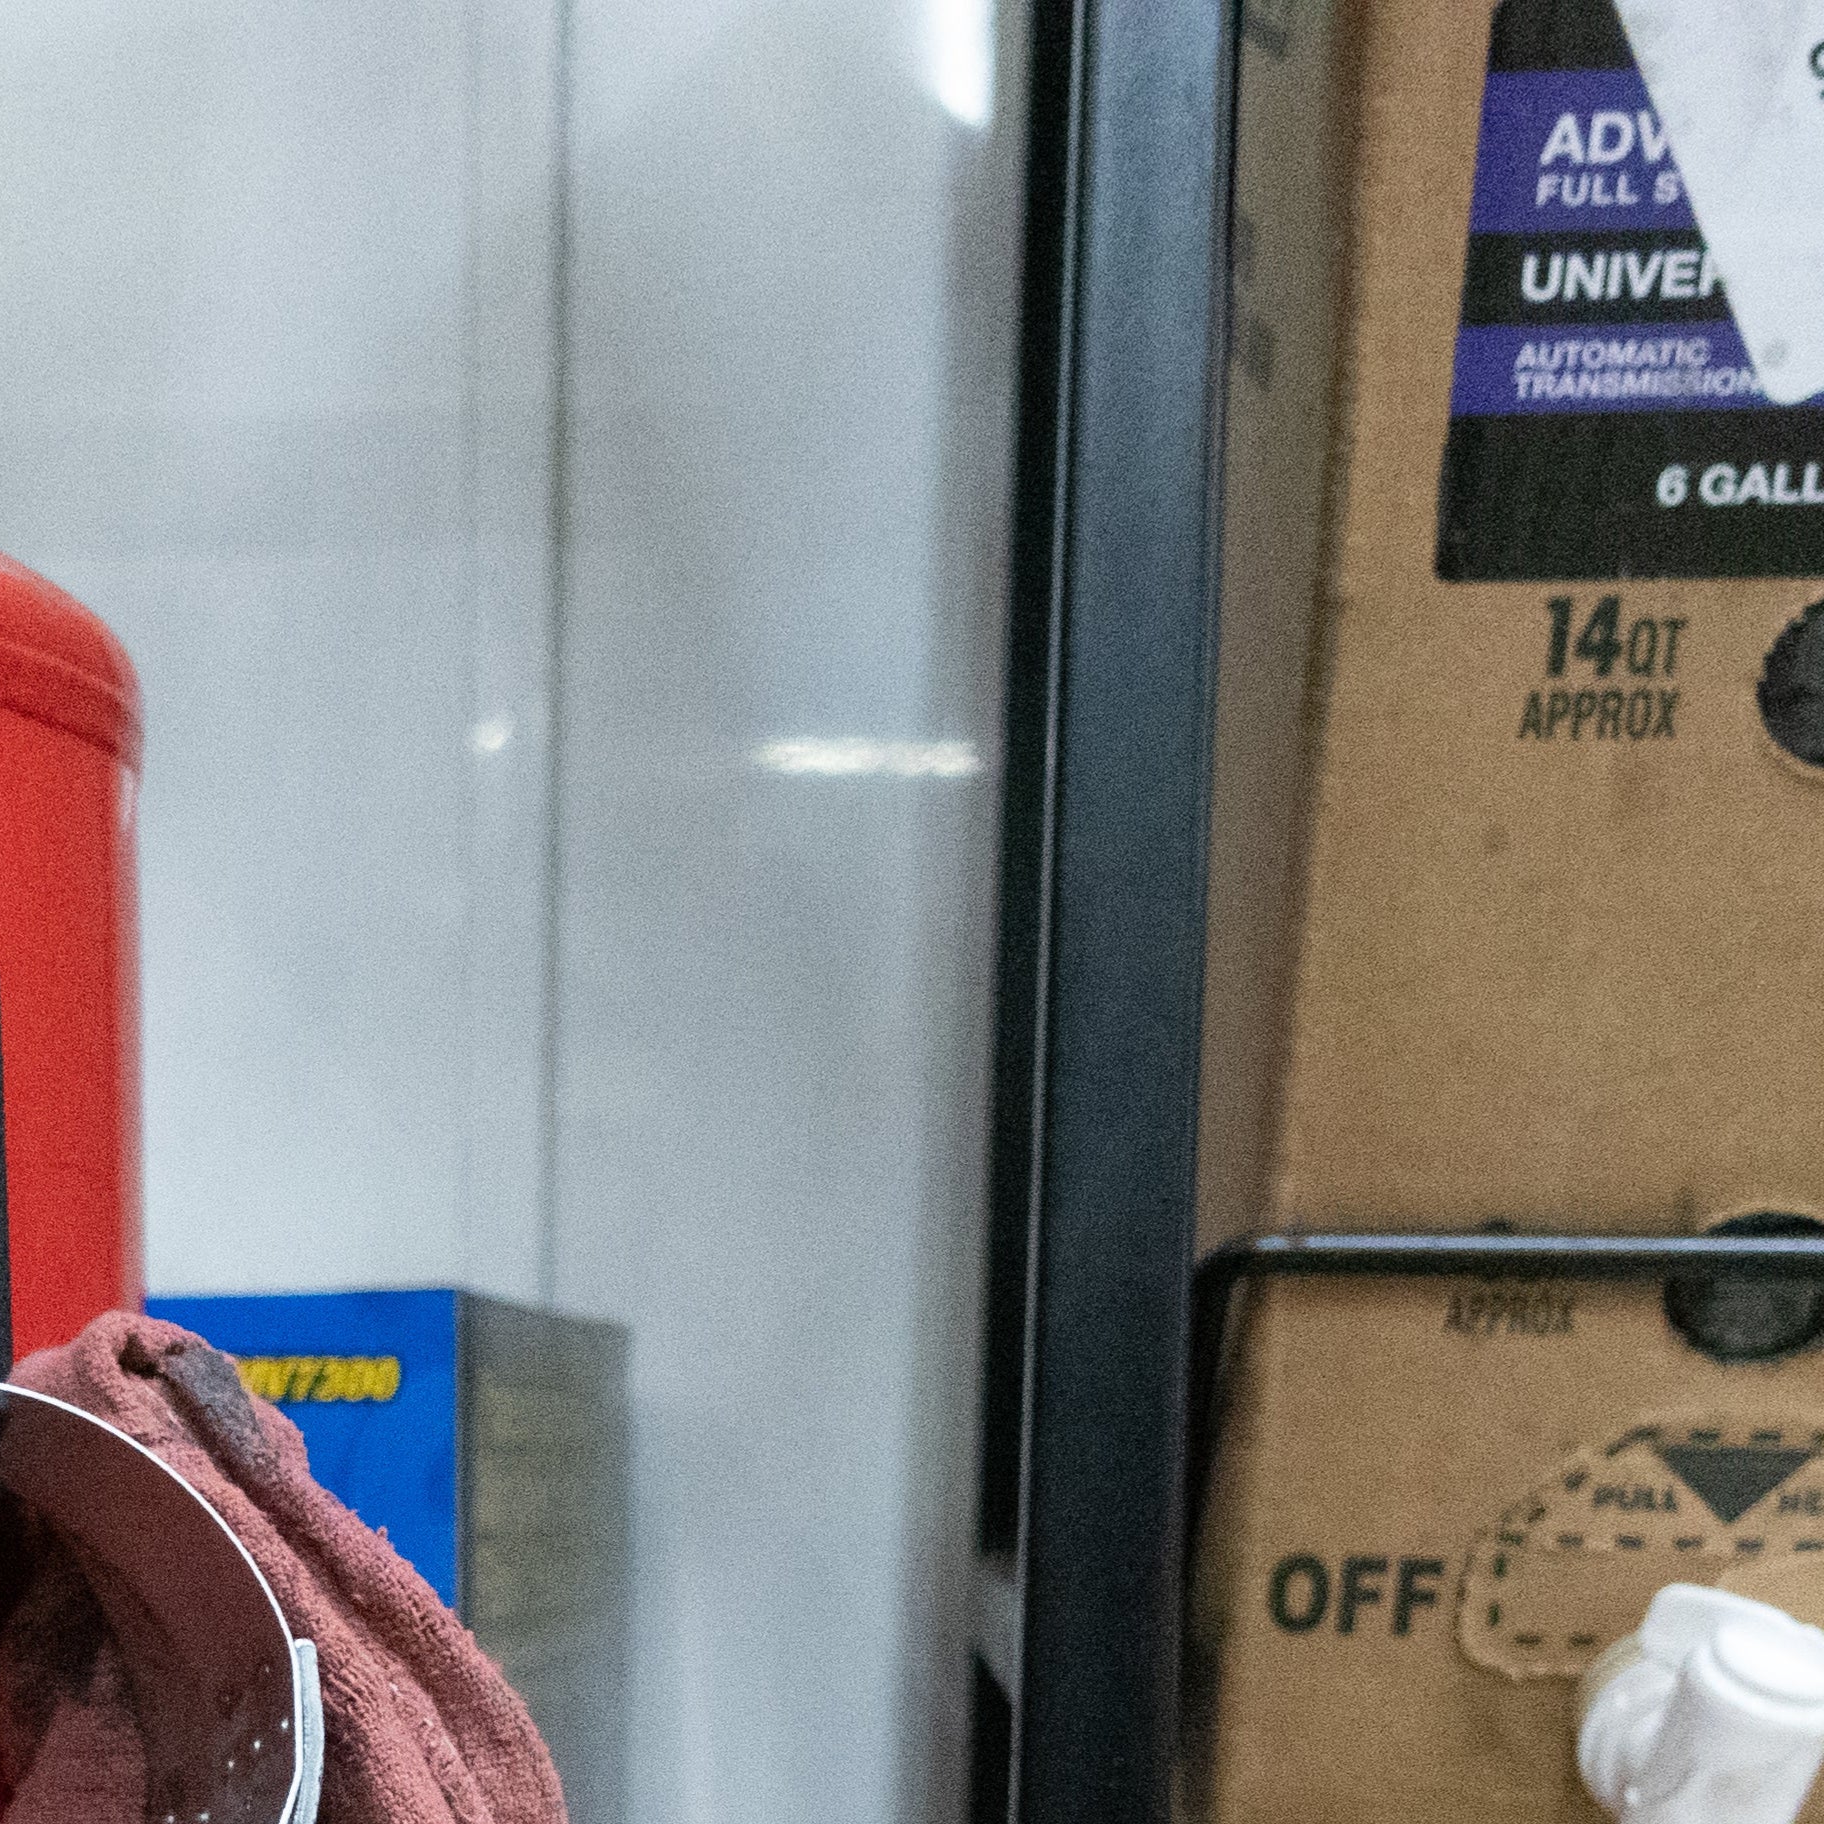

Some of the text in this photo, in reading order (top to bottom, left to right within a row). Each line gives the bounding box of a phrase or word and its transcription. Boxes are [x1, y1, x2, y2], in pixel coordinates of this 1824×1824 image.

[1535, 171, 1639, 208] FULL
[1513, 337, 1711, 370] AUTOMATIC
[1656, 460, 1824, 509] 6 GALL
[1517, 688, 1679, 742] APPROX
[1268, 1551, 1446, 1639] OFF
